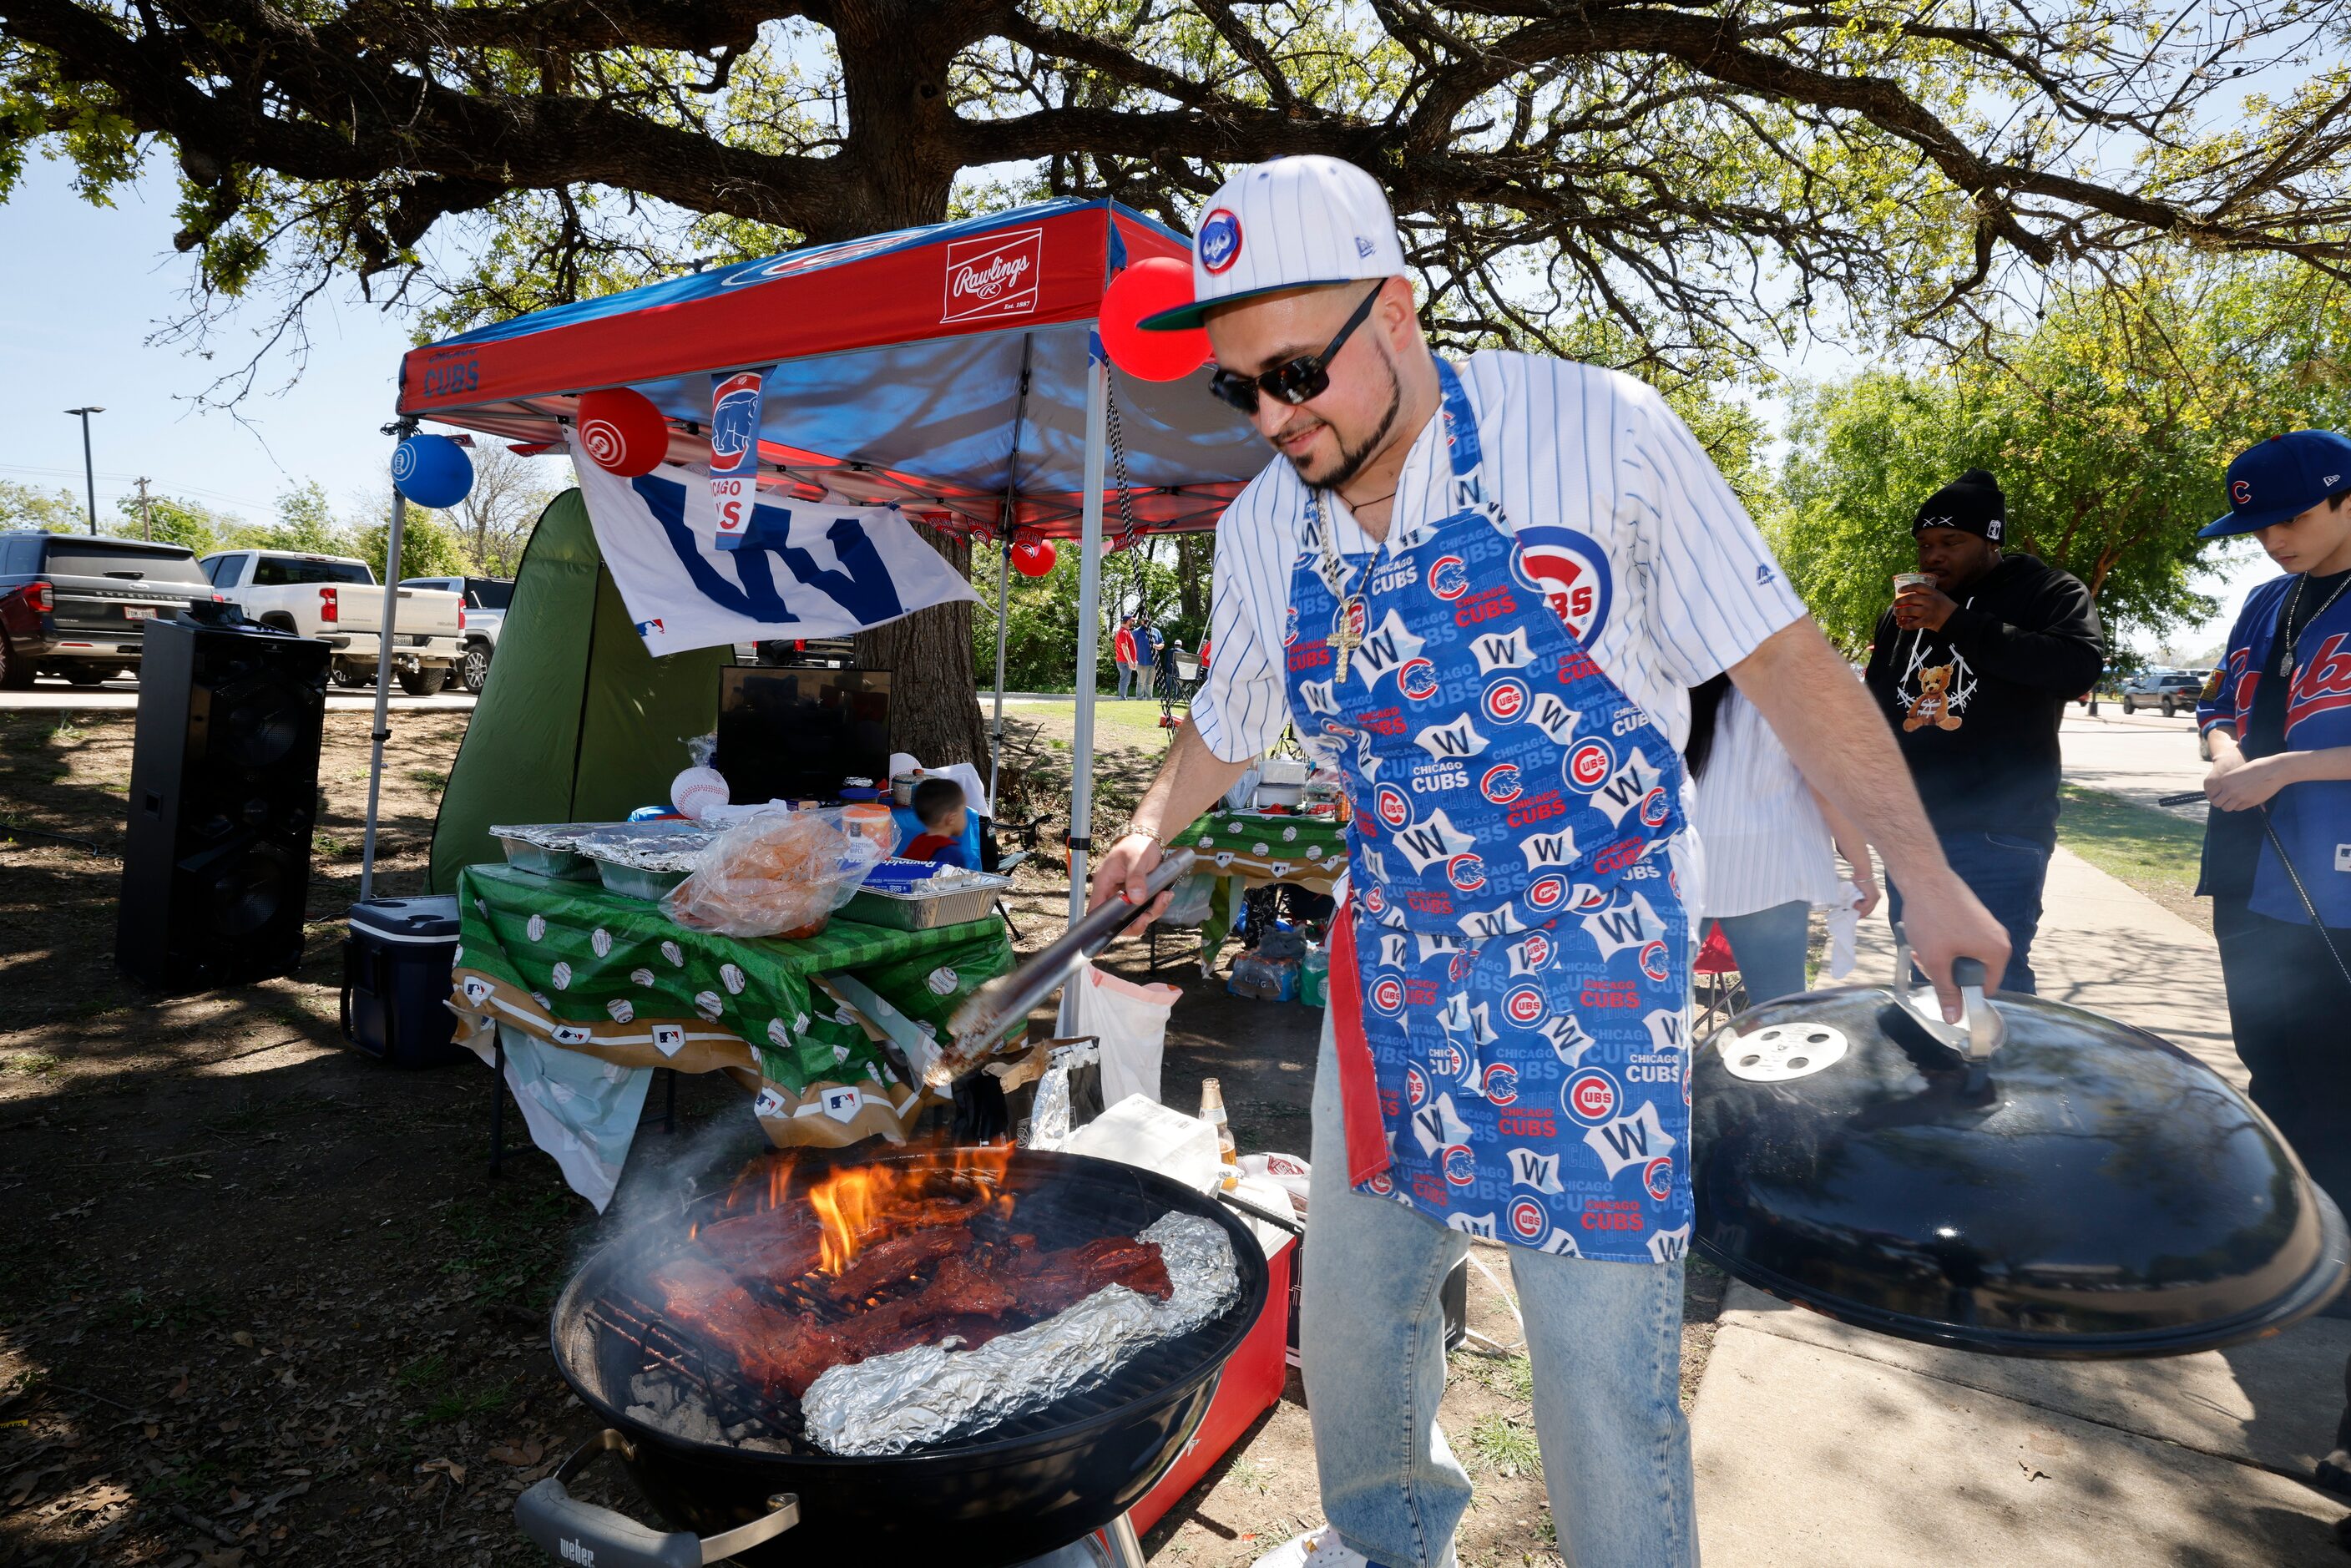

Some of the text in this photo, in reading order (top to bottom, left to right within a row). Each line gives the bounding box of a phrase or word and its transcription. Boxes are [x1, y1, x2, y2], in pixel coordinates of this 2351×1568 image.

[953, 255, 1029, 297] Rawlings
[424, 361, 479, 398] CUBS
[2232, 481, 2252, 503] C
[1438, 526, 1494, 551] CHICAGO
[1372, 555, 1414, 578] CHICAGO
[1371, 566, 1418, 596] CUBS
[96, 591, 182, 601] EXPEDITION
[1454, 585, 1509, 609] CHICAGO
[1454, 595, 1518, 628] CUBS
[1287, 640, 1327, 655] CHICAGO
[1288, 649, 1331, 672] CUBS
[1360, 626, 1400, 670] W
[1484, 637, 1515, 665] W
[1558, 660, 1604, 685] CUB
[1306, 685, 1329, 711] W
[1491, 685, 1521, 716] CUBS
[1540, 700, 1571, 734] W
[1611, 711, 1649, 737] CUB
[1432, 725, 1470, 756] W
[1493, 735, 1548, 761] CHICAGO
[1413, 761, 1464, 776] CHICAGO
[1574, 746, 1606, 784] CUBS
[1411, 770, 1470, 794] CUBS
[1603, 765, 1643, 808] W
[1506, 798, 1566, 828] CUBS
[1509, 789, 1560, 812] CHICAGO
[1402, 822, 1449, 860] W
[1533, 836, 1563, 862] W
[1595, 836, 1643, 859] CHICAGO
[1408, 898, 1454, 915] CUBS
[1475, 910, 1507, 936] W
[1598, 906, 1646, 944] W
[1378, 980, 1401, 1011] CUBS
[1584, 979, 1637, 990] CHICAGO
[1511, 991, 1540, 1022] CUBS
[1580, 990, 1641, 1009] CUBS
[1553, 1015, 1585, 1052] W
[1495, 1048, 1555, 1060] CHICAGO
[1630, 1055, 1679, 1064] CHICAGO
[1625, 1065, 1679, 1084] CUBS
[1573, 1077, 1612, 1117] CUBS
[1500, 1107, 1554, 1118] CHICAGO
[1498, 1118, 1558, 1138] CUBS
[1601, 1116, 1649, 1161] W
[1520, 1153, 1550, 1187] W
[1412, 1181, 1449, 1207] CUBS
[1585, 1200, 1641, 1211] CHICAGO
[1514, 1201, 1541, 1236] CUBS
[1580, 1211, 1645, 1231] CUBS
[560, 1538, 594, 1568] weber
